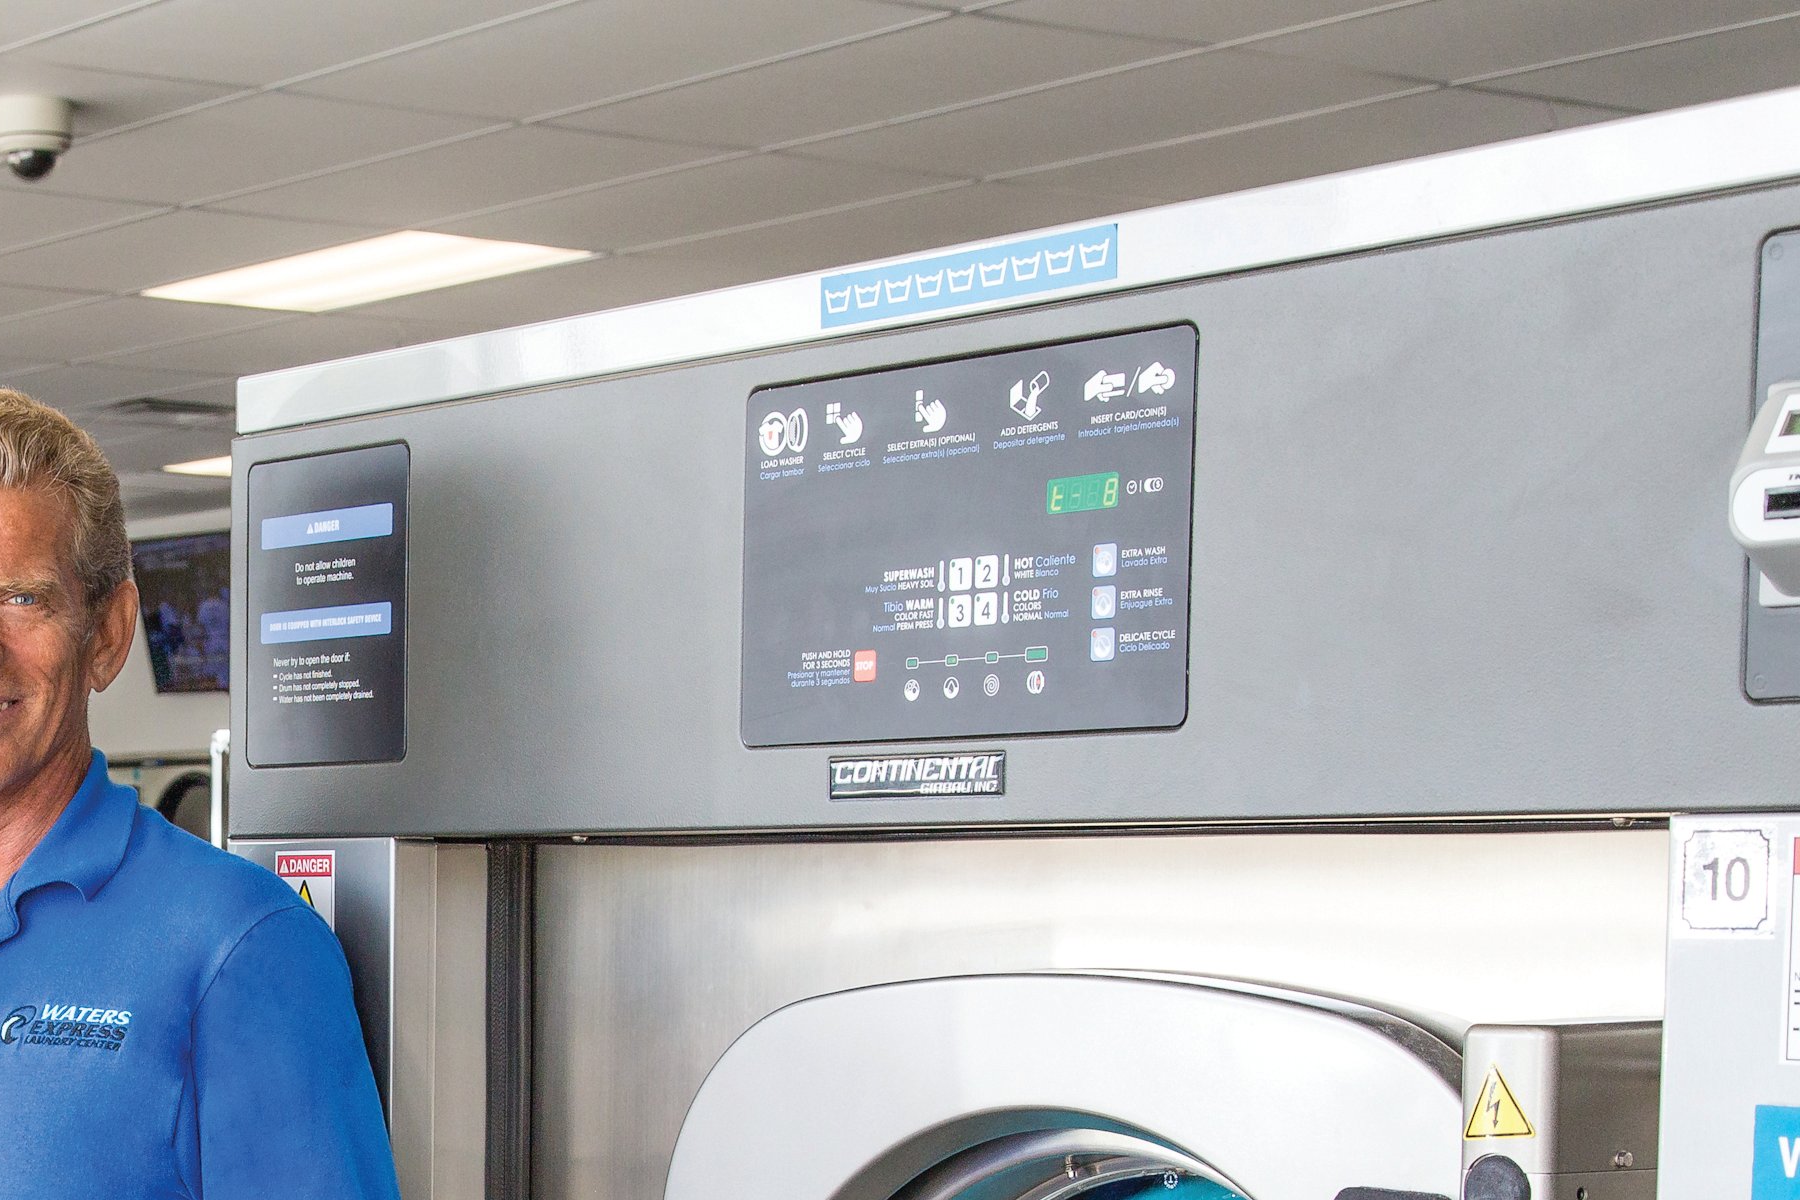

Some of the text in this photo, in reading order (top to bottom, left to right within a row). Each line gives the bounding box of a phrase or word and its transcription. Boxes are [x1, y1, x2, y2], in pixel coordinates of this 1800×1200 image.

[1091, 406, 1167, 424] INSERT CARD/COIN(S)
[1001, 421, 1058, 437] ADD DETERGENTS
[1078, 416, 1179, 438] Introducir tarjeta/moneda(s)
[887, 432, 975, 452] SELECT EXTRA(S) (OPTIONAL)
[993, 432, 1065, 449] Depositar detergente
[823, 448, 865, 460] SELECT CYCLE
[883, 444, 979, 464] Seleccionar extra(s) (opcional)
[761, 456, 803, 469] LOAD WASHER
[818, 459, 870, 472] Seleccionar ciclo
[760, 468, 804, 480] Cargar tambor
[314, 520, 339, 533] DANGER
[1122, 546, 1165, 558] EXTRA WASH
[295, 558, 355, 573] Do not allow children
[1015, 554, 1076, 569] HOT Caliente
[1122, 556, 1167, 567] Lavado Extra
[297, 576, 302, 585] to
[304, 574, 325, 586] operate
[884, 567, 934, 582] SUPERWASH
[958, 567, 962, 584] 1
[983, 565, 991, 582] 2
[1014, 568, 1058, 579] WHITE Blanco
[880, 584, 896, 592] Sucio
[898, 582, 919, 590] HEAVY
[921, 580, 934, 588] SOIL
[1014, 589, 1040, 601] COLD
[1121, 588, 1163, 599] EXTRA RINSE
[884, 598, 933, 612] Tibio WARM
[982, 601, 990, 619] 4
[1013, 602, 1041, 611] COLORS
[1120, 597, 1172, 610] Enjuague Extra
[894, 611, 933, 621] COLOR FAST
[956, 604, 964, 622] 3
[1013, 609, 1069, 621] NORMAL Normal
[873, 621, 933, 632] Normal PERM PRESS
[1120, 630, 1175, 642] DELICATE CYCLE
[1119, 642, 1170, 652] Ciclo Delicado
[274, 658, 290, 667] Never
[299, 657, 304, 665] to
[306, 657, 320, 666] open
[321, 654, 329, 664] the
[331, 653, 344, 663] door
[802, 650, 851, 660] PUSH AND HOLD
[817, 661, 820, 669] 3
[821, 659, 850, 668] SECONDS
[856, 661, 873, 670] STOP
[279, 673, 292, 682] Cycle
[294, 672, 302, 680] has
[303, 671, 311, 679] not
[788, 671, 814, 679] Presionar
[821, 677, 850, 686] segundos
[293, 683, 302, 691] has
[303, 683, 311, 691] not
[294, 695, 302, 703] has
[303, 694, 312, 702] not
[833, 755, 1002, 785] CONTINENTAL
[290, 859, 330, 873] DANGER
[1703, 857, 1750, 901] 10
[42, 1003, 132, 1025] WATERS
[29, 1020, 127, 1041] EXPRESS
[24, 1034, 121, 1052] LAUNDRY CENTER
